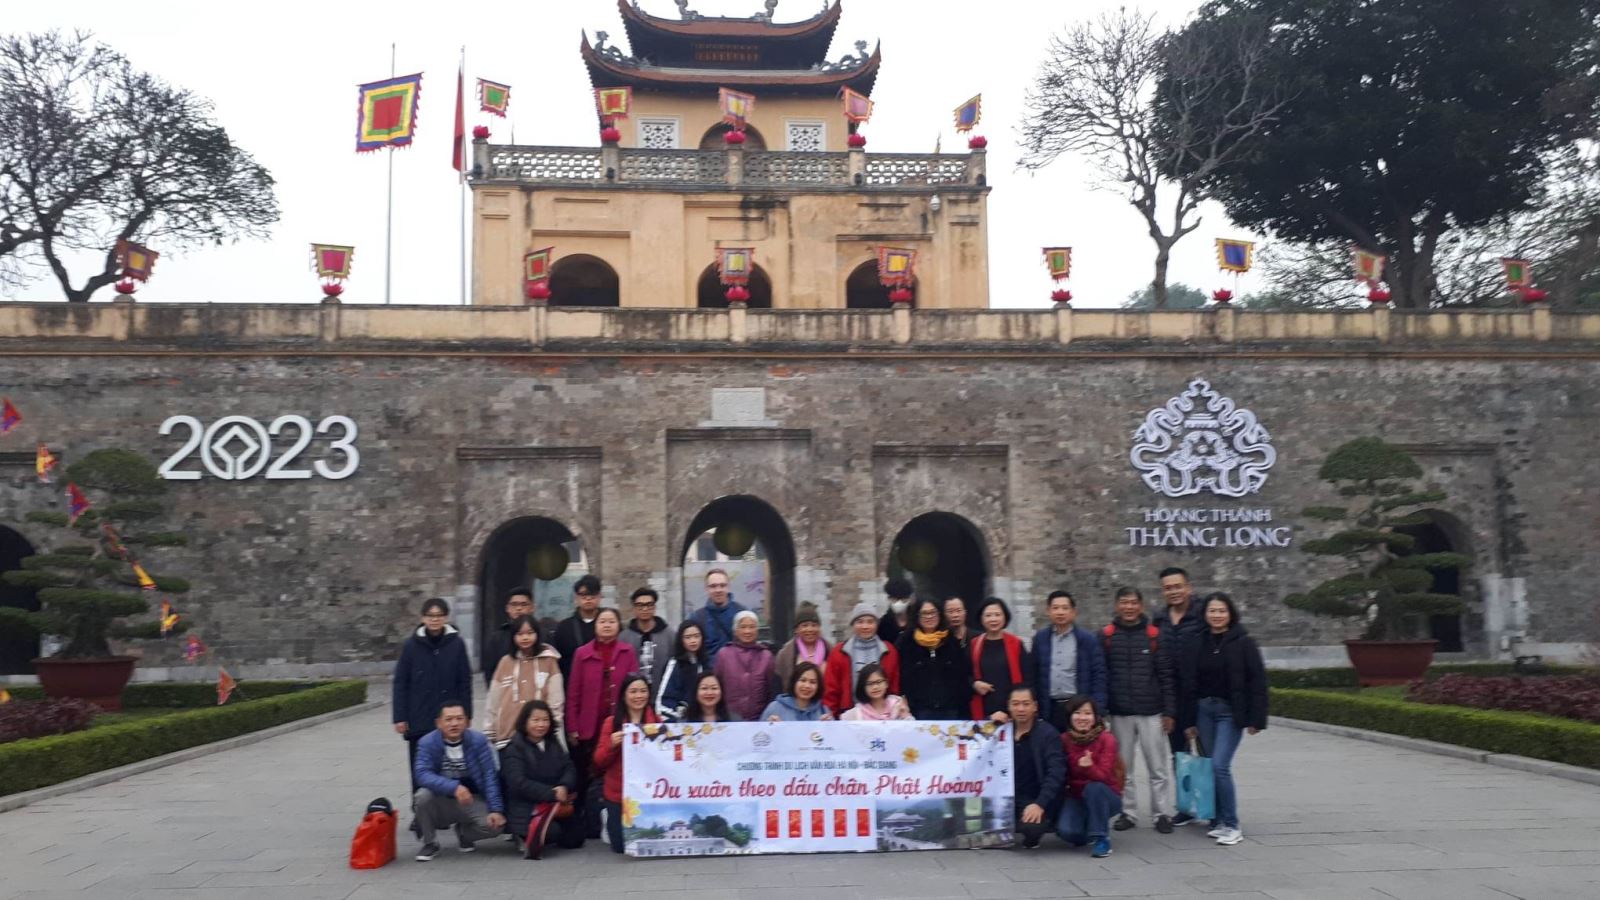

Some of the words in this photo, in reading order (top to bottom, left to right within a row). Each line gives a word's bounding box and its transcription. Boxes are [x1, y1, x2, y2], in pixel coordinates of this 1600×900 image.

[157, 415, 360, 480] 2023
[1125, 523, 1218, 547] THĂNG
[1225, 526, 1291, 547] LONG
[687, 780, 733, 799] xuân
[738, 778, 776, 797] theo
[783, 774, 820, 797] dấu
[825, 776, 870, 796] chân
[874, 774, 922, 799] Phật
